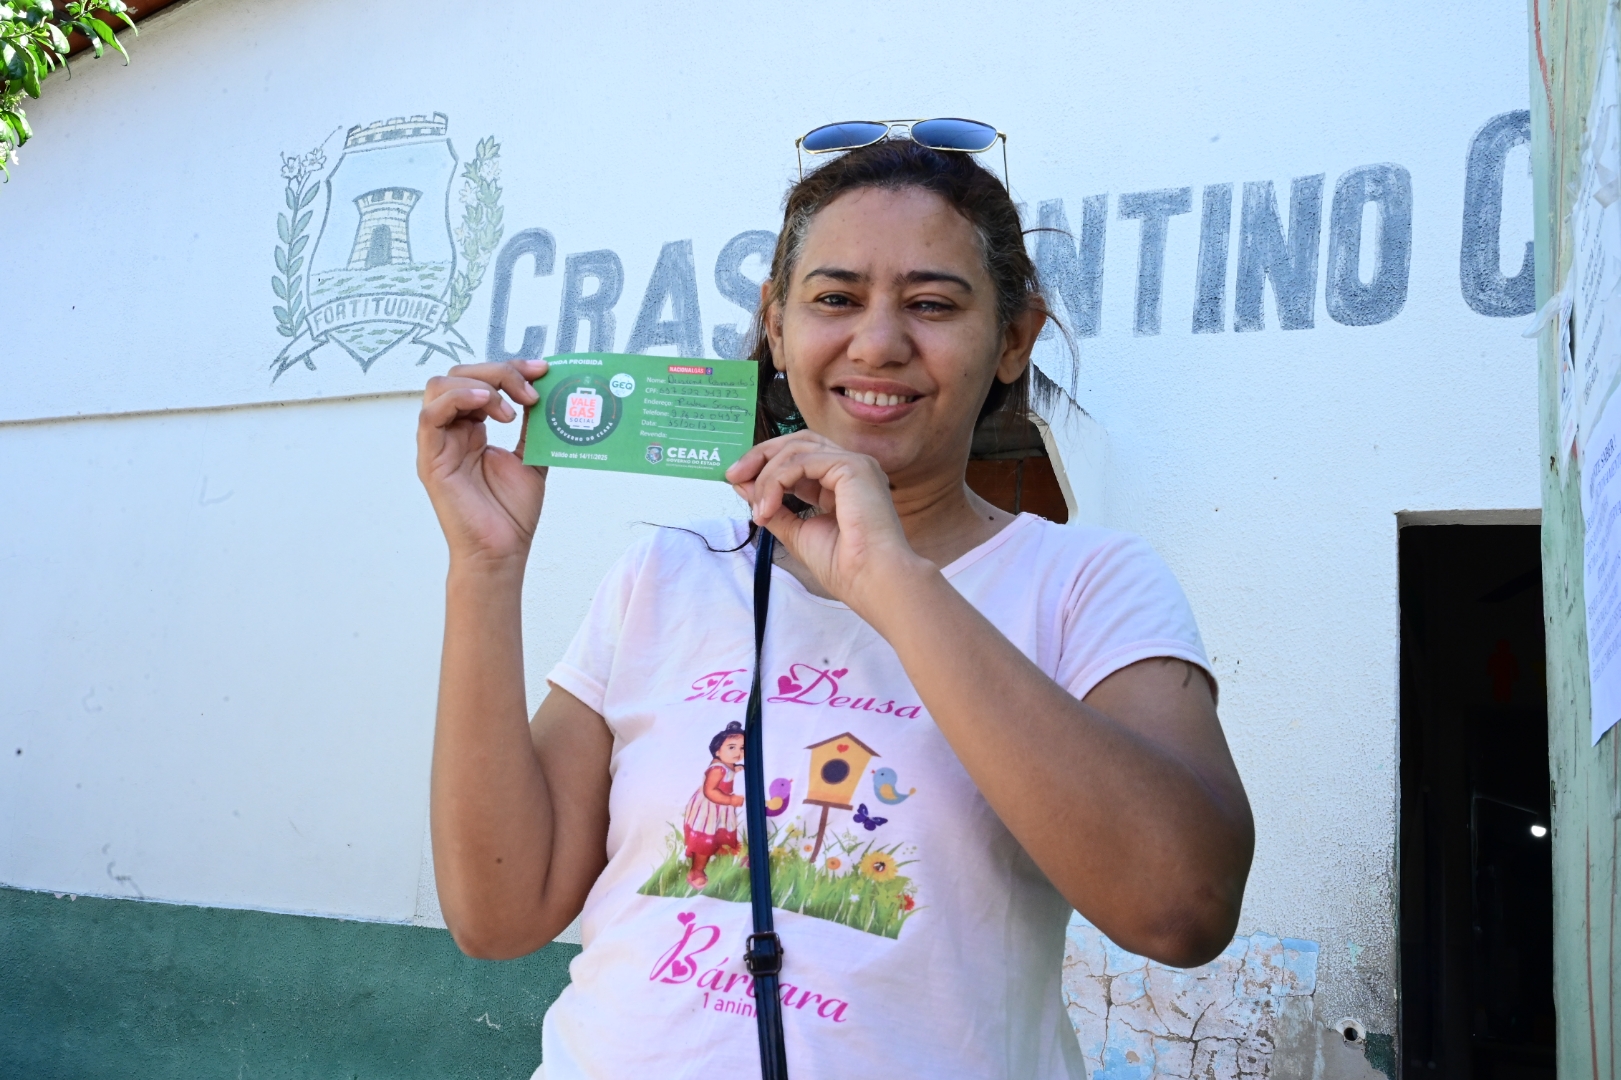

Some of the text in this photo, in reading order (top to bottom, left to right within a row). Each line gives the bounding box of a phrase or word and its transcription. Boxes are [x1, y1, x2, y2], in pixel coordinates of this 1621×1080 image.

[486, 227, 778, 362] CRAS
[1013, 163, 1414, 342] NTINO
[313, 296, 439, 326] FORTITUDINE
[548, 359, 568, 367] ENDA
[646, 376, 667, 384] Nome:
[571, 397, 597, 408] VALE
[643, 398, 674, 407] Endereço:
[569, 406, 596, 419] GAS
[641, 419, 658, 427] Data:
[640, 430, 668, 438] Revenda:
[551, 451, 569, 459] Válido
[667, 446, 721, 462] CEARÁ
[766, 663, 923, 720] Deusa
[650, 914, 849, 1023] Bárara
[714, 997, 758, 1019] anin
